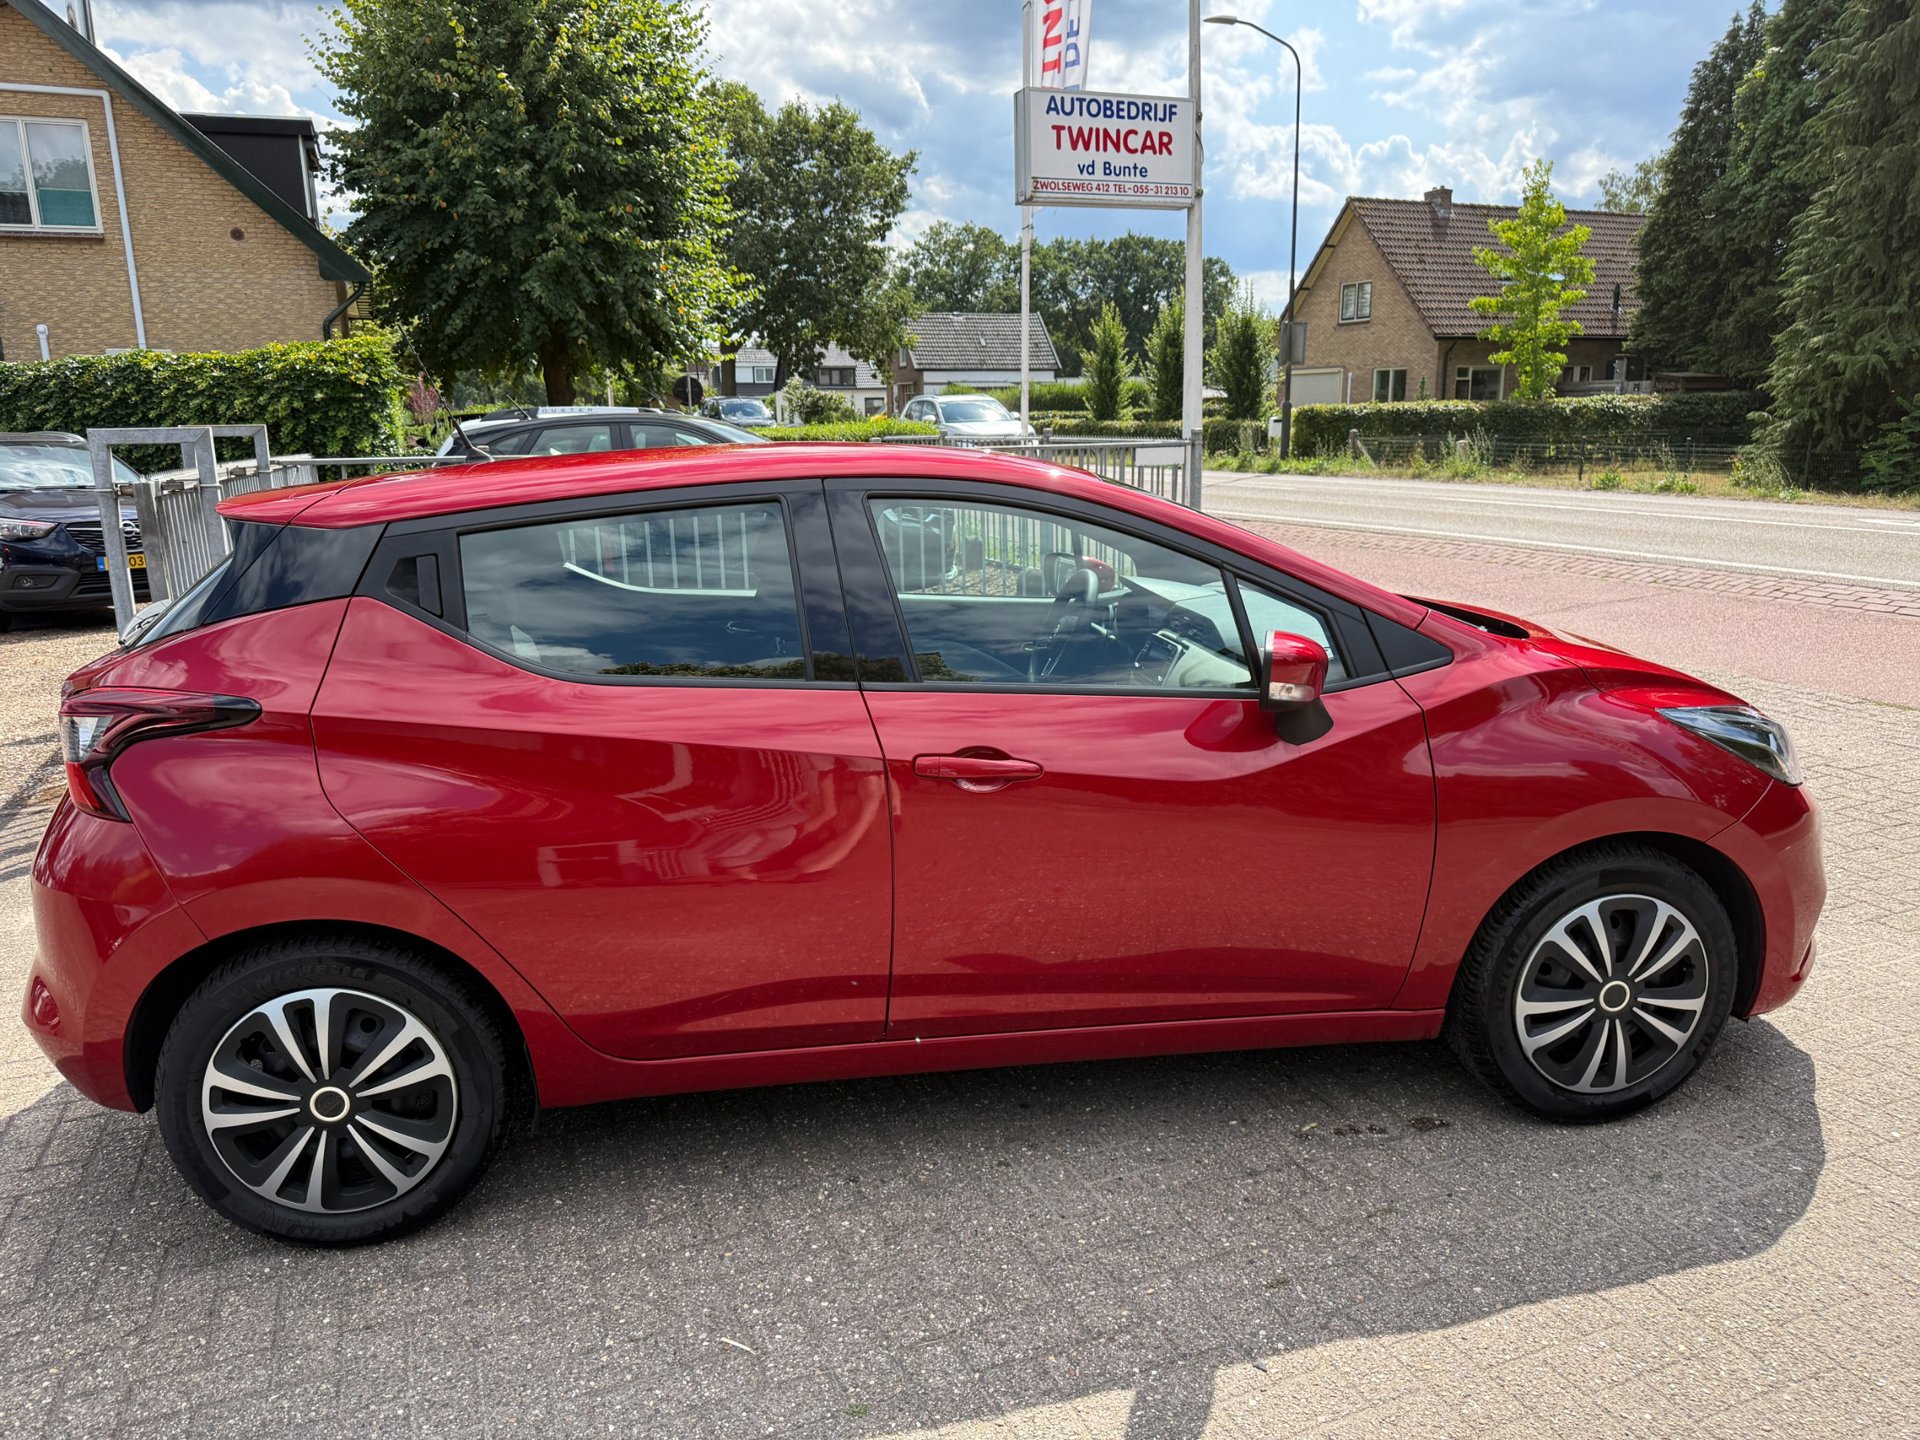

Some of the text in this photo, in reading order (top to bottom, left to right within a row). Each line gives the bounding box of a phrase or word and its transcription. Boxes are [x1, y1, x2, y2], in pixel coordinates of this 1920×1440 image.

[1046, 95, 1177, 123] AUTOBEDRIJF
[1051, 125, 1173, 156] TWINCAR
[1078, 160, 1148, 178] vd Bunte
[1033, 180, 1093, 192] ZWOLSEWEG
[1095, 183, 1110, 193] 412
[129, 556, 144, 567] 03
[255, 964, 368, 989] MICHELIN
